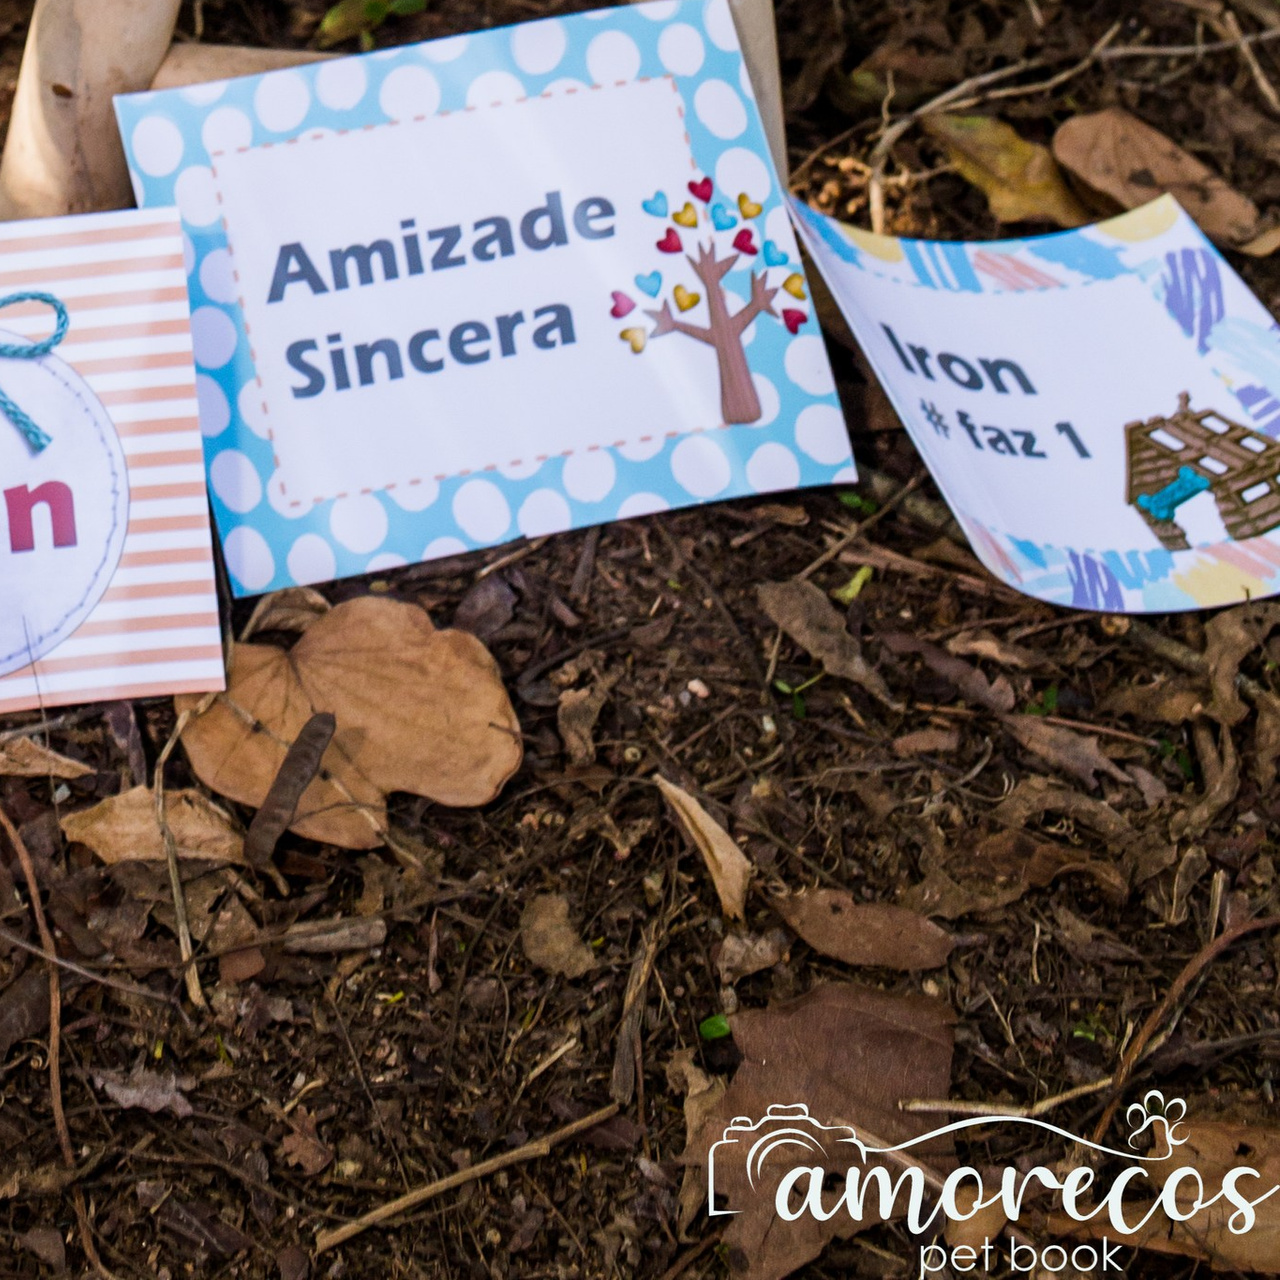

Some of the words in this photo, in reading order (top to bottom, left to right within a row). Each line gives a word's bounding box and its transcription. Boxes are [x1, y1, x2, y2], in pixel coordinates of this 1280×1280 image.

[265, 189, 618, 304] Amizade
[284, 302, 578, 399] Sincera
[879, 321, 1039, 396] Iron
[955, 409, 1048, 460] faz
[1054, 420, 1094, 459] 1
